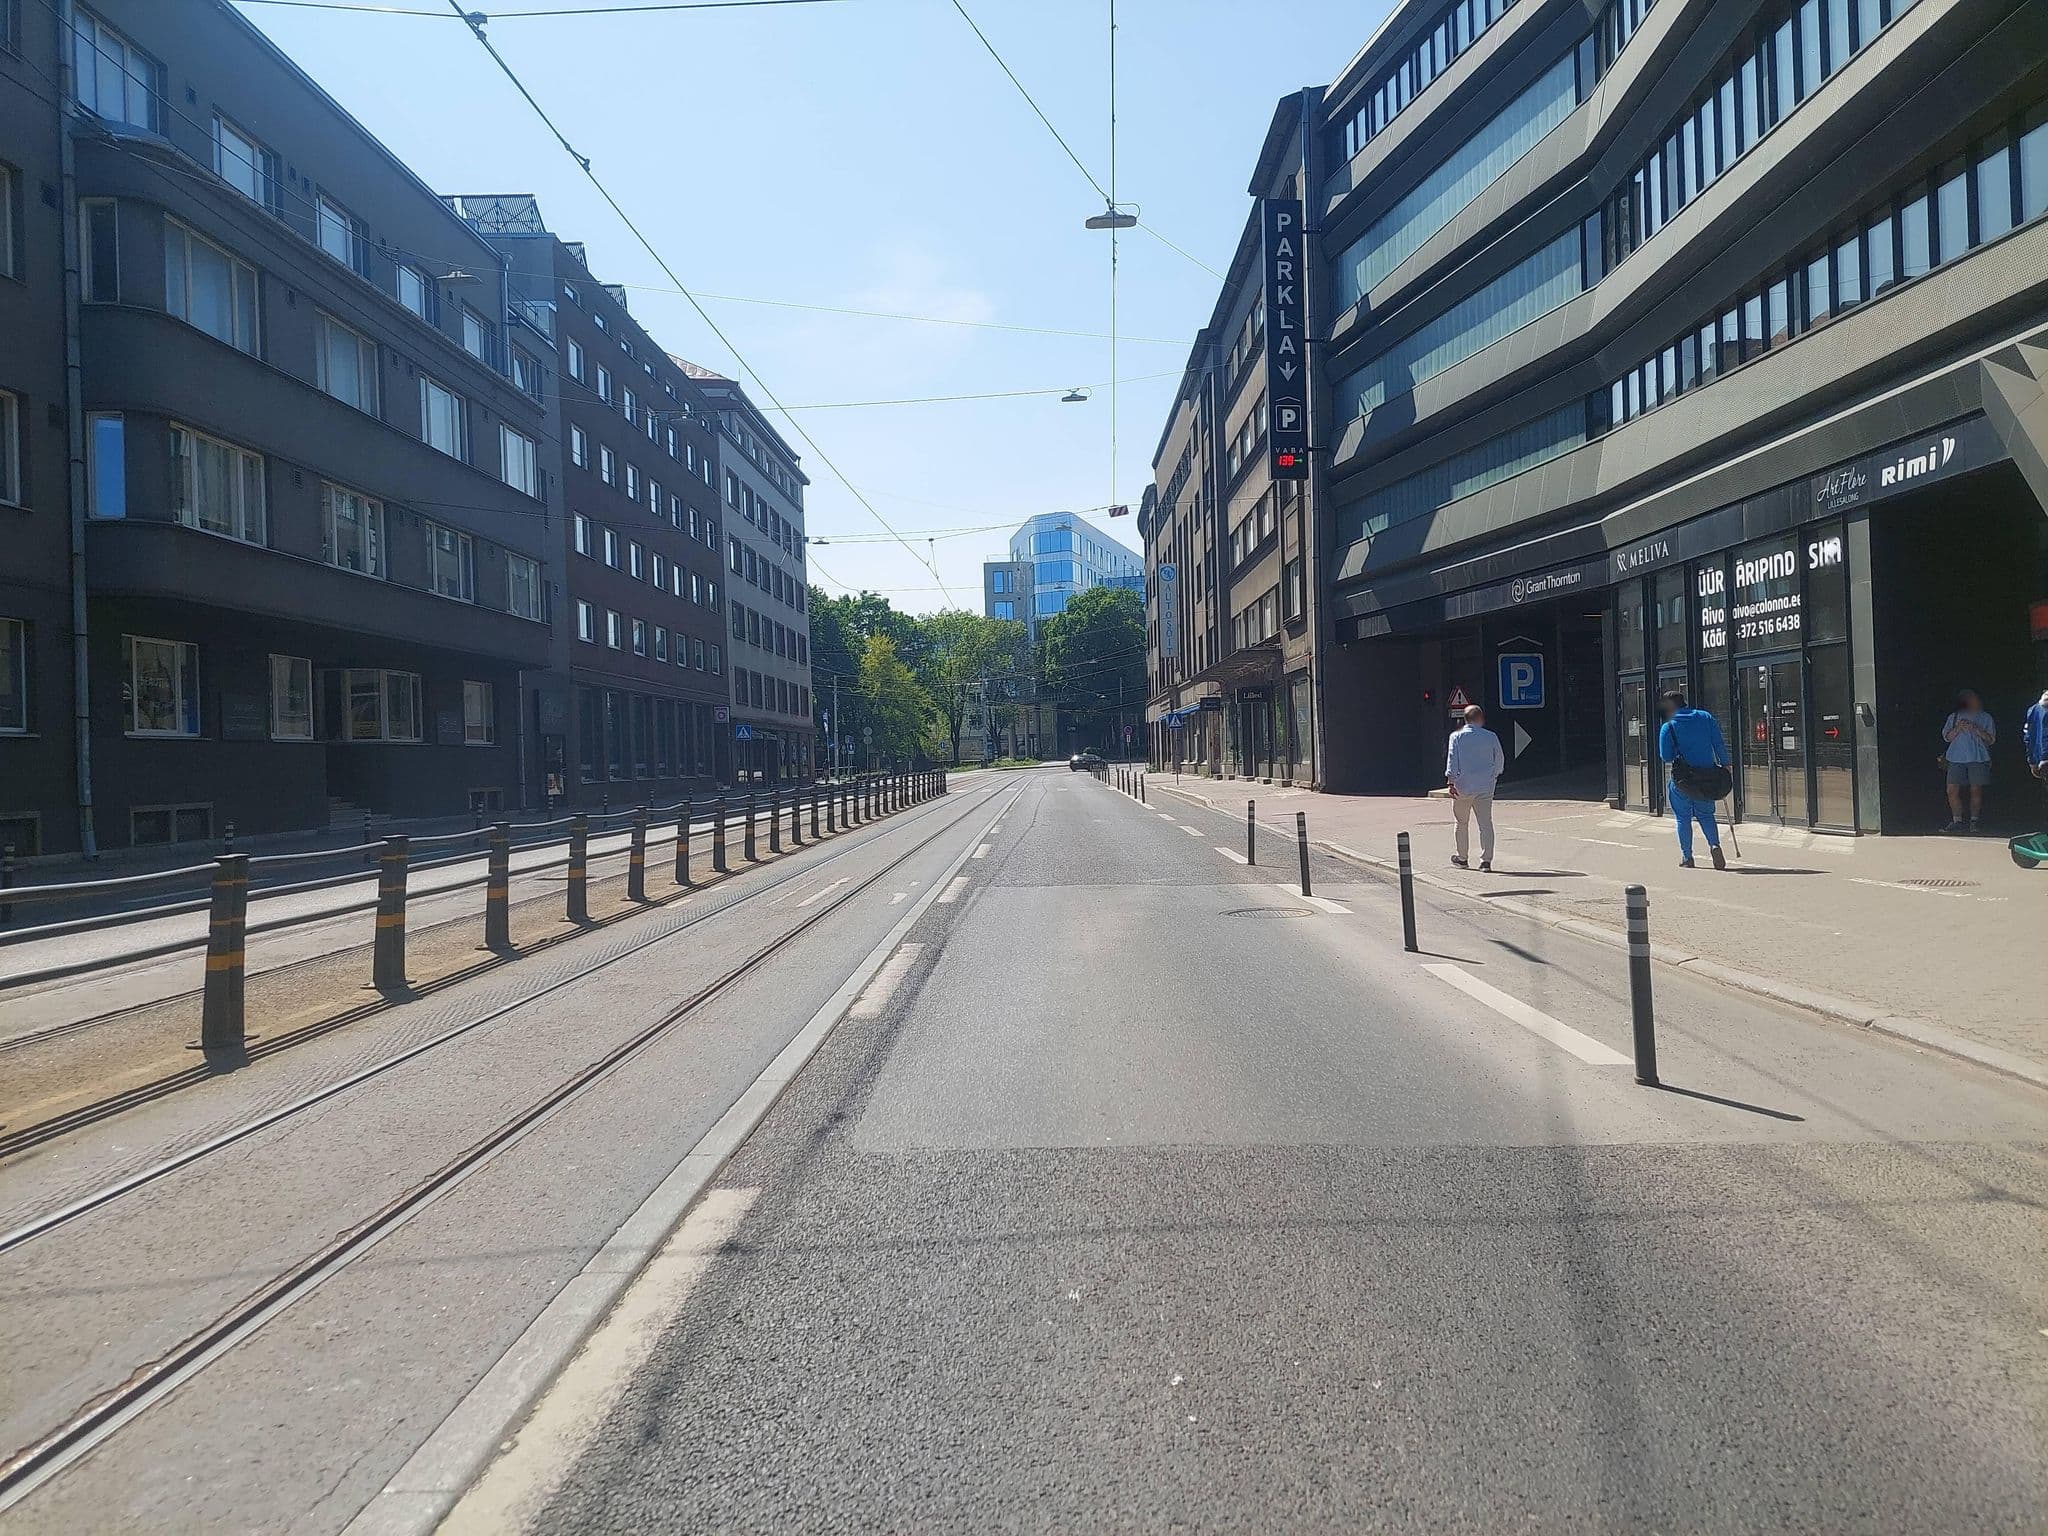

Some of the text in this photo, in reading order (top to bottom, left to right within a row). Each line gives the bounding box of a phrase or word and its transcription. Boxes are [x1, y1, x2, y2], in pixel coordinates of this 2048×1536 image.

[1276, 212, 1296, 355] PARKLA
[1281, 408, 1296, 428] P
[1881, 446, 1937, 487] Rimi
[1629, 540, 1669, 569] MELIVA
[1698, 566, 1725, 597] ÜÜR
[1735, 550, 1796, 589] ÄRIPIND
[1702, 593, 1801, 627] Aivo aivo@colonna.ee
[1702, 613, 1801, 646] Käär +372 516 6438
[1510, 662, 1534, 701] P
